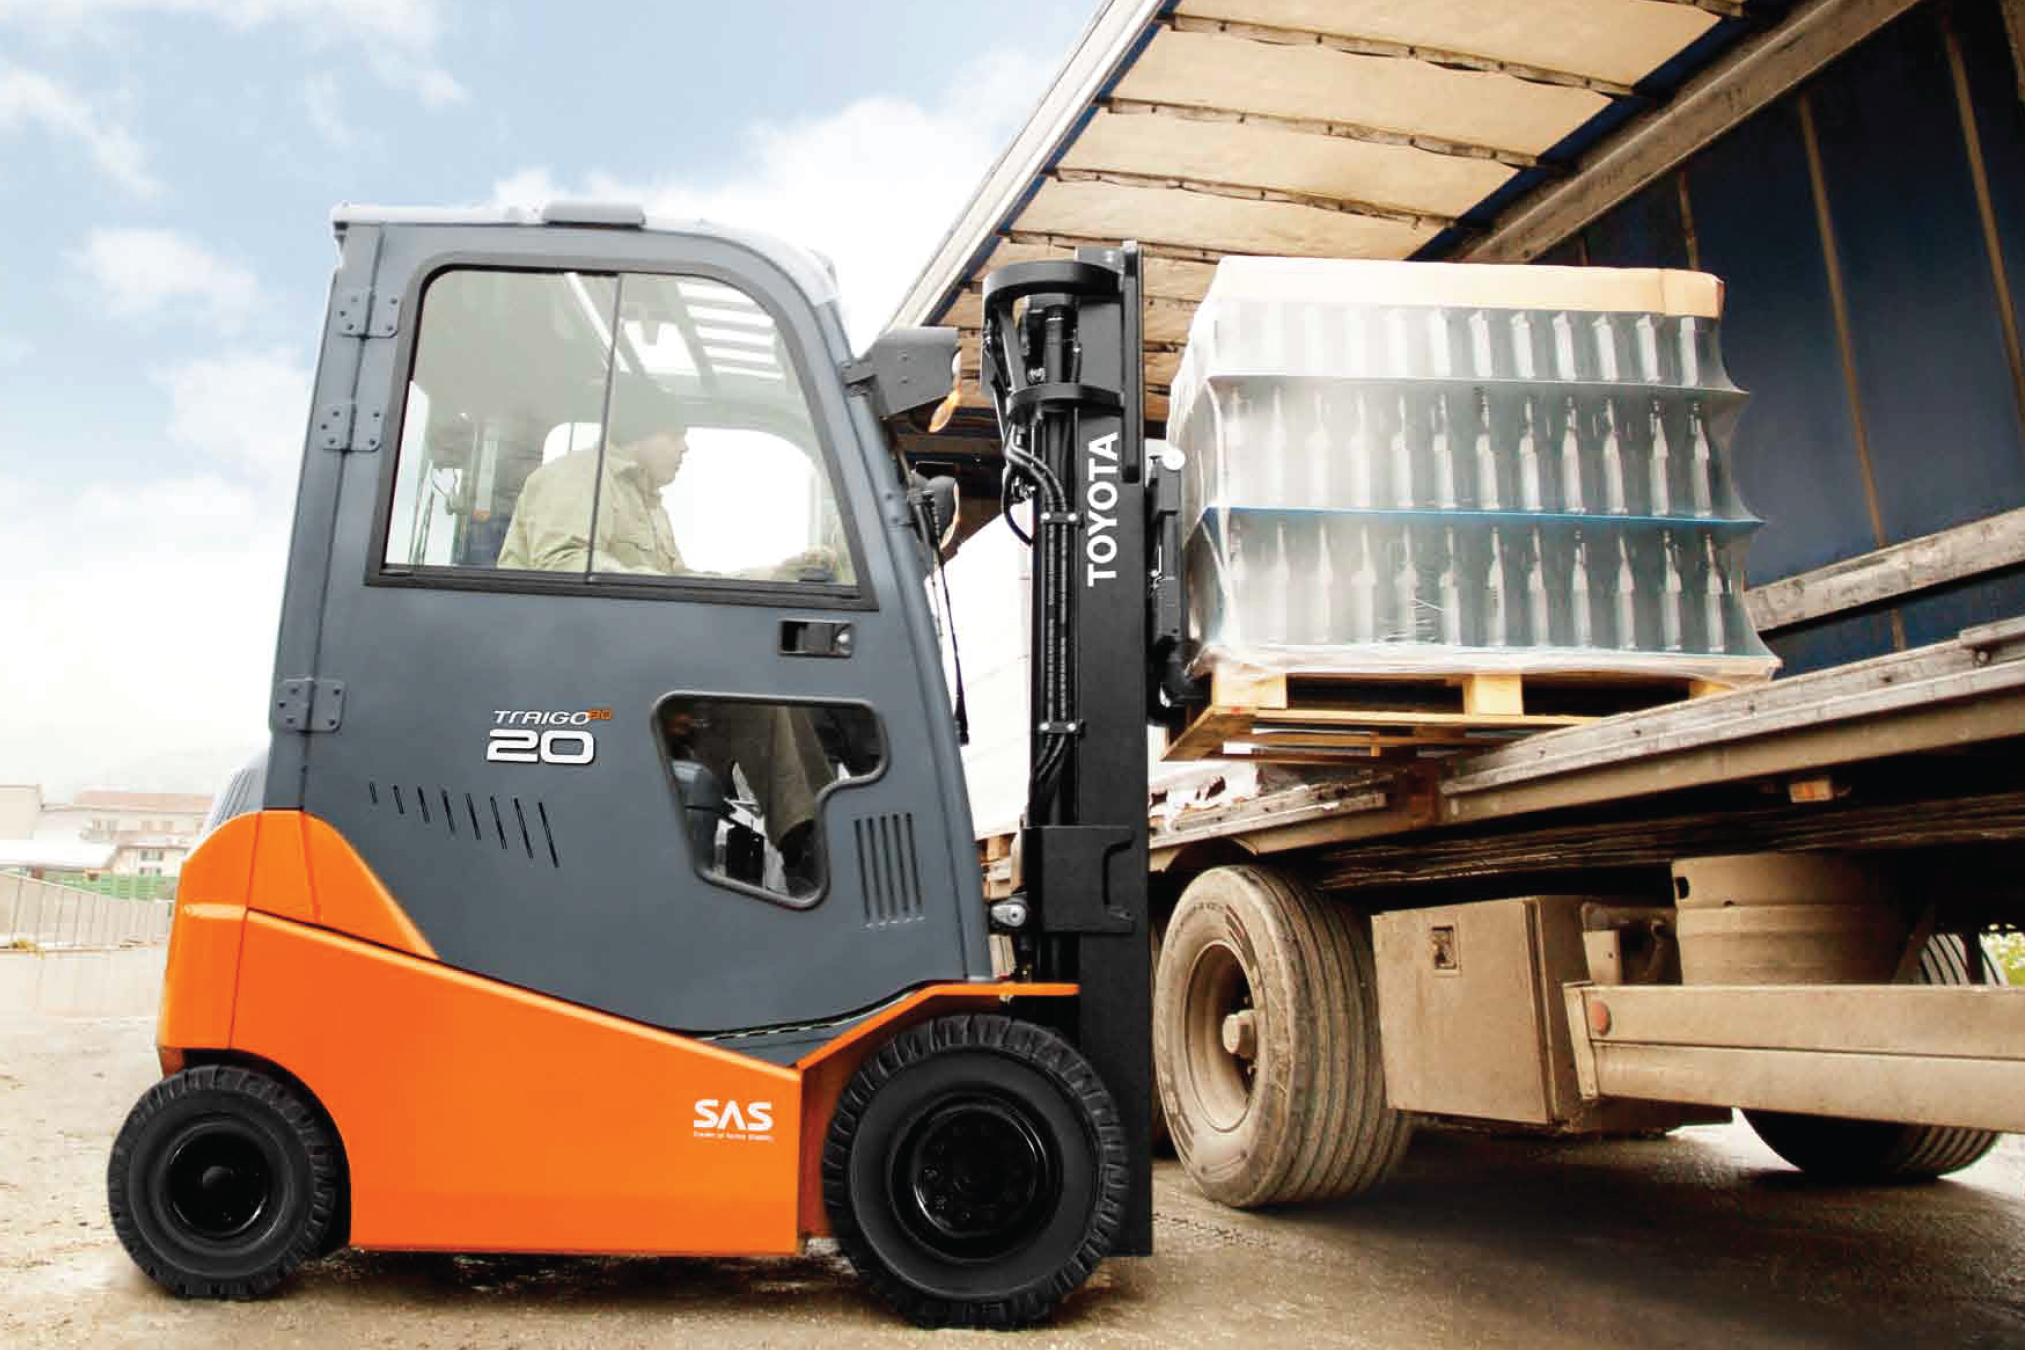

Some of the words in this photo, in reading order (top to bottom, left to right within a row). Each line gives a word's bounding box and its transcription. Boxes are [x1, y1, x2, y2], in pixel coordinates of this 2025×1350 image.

[1086, 431, 1119, 588] TOYOTA
[493, 709, 591, 725] TRAIGO
[487, 729, 594, 764] 20
[693, 1099, 773, 1131] SAS
